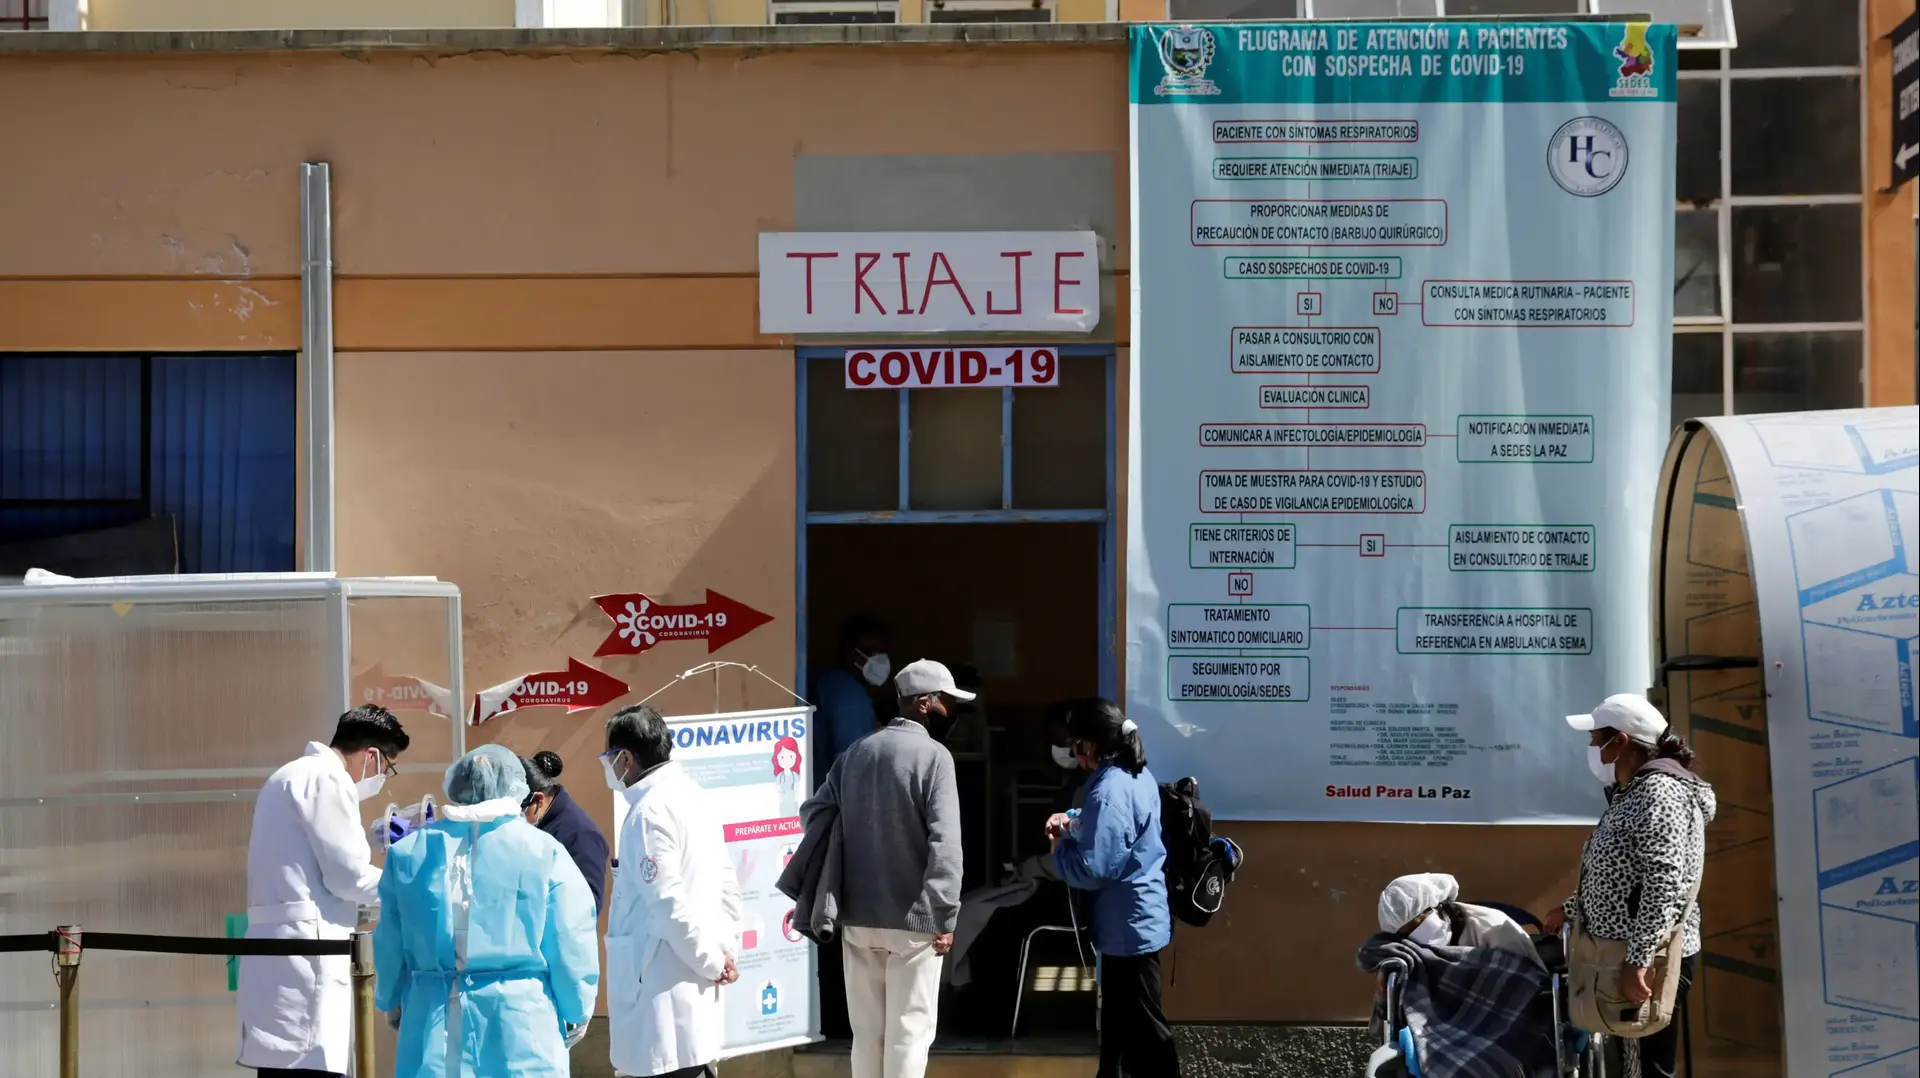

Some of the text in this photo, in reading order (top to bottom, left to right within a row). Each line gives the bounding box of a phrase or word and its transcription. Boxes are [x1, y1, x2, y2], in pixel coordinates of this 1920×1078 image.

[1238, 25, 1568, 51] FLUGRAMA DE ATENCIÓN A PACIENTES
[1283, 53, 1523, 77] CON SOSPECHA DE COVID-19
[1619, 78, 1648, 88] SEDES
[1217, 124, 1418, 140] PACIENTE CON SÍNTOMAS RESPIRATORIOS
[1219, 164, 1412, 178] REQUIERE ATENCIÓN INMEDIATA (TRIAJE)
[1251, 205, 1388, 217] PROPORCIONAR MEDIDAS DE
[1197, 224, 1443, 241] PRECAUCIÓN DE CONTACTO (BARBIJO QUIRÚRGICO)
[1239, 262, 1388, 274] CASO SOSPECHOS DE COVID-19
[786, 251, 1084, 315] TRIAJE
[1430, 286, 1480, 298] CONSULTA
[1522, 286, 1573, 298] RUTINARIA
[1584, 286, 1629, 298] PACIENTE
[1304, 298, 1312, 310] SI
[1380, 298, 1393, 310] NO
[1455, 306, 1606, 320] CON SÍNTOMAS RESPIRATORIOS
[1240, 332, 1374, 344] PASAR A CONSULTORIO CON
[1240, 354, 1373, 366] AISLAMIENTO DE CONTACTO
[848, 349, 1055, 386] COVID-19
[1264, 388, 1365, 403] EVALUACIÓN CLINICA
[1470, 420, 1589, 435] NOTIFICACIÓN INMEDIATA
[1205, 430, 1262, 442] COMUNICAR
[1265, 430, 1272, 441] A
[1491, 444, 1566, 457] A SEDES LA PAZ
[1206, 475, 1422, 488] TOMA DE MUESTRA PARA COVID-19 Y ESTUDIO
[1215, 497, 1227, 509] DE
[1230, 497, 1257, 509] CASO
[1260, 497, 1272, 509] DE
[1275, 497, 1329, 509] VIGILANCIA
[1194, 529, 1290, 541] TIENE CRITERIOS DE
[1455, 531, 1589, 544] AISLAMIENTO DE CONTACTO
[1367, 540, 1375, 552] SI
[1210, 548, 1274, 563] INTERNACIÓN
[1454, 553, 1588, 566] EN CONSULTORIO DE TRIAJE
[1235, 578, 1248, 590] NO
[636, 611, 727, 631] COVID-19
[1204, 609, 1270, 621] TRATAMIENTO
[1425, 614, 1577, 627] TRANSFERENCIA A HOSPITAL DE
[1171, 630, 1303, 644] SINTOMATICO DOMICILIARIO
[1416, 636, 1586, 649] REFERENCIA EN AMBULANCIA SEMA
[1193, 663, 1280, 675] SEGUIMIENTO POR
[1326, 785, 1470, 798] Salud Para La Paz
[735, 825, 772, 836] PREPÁRATE
[772, 824, 778, 832] Y
